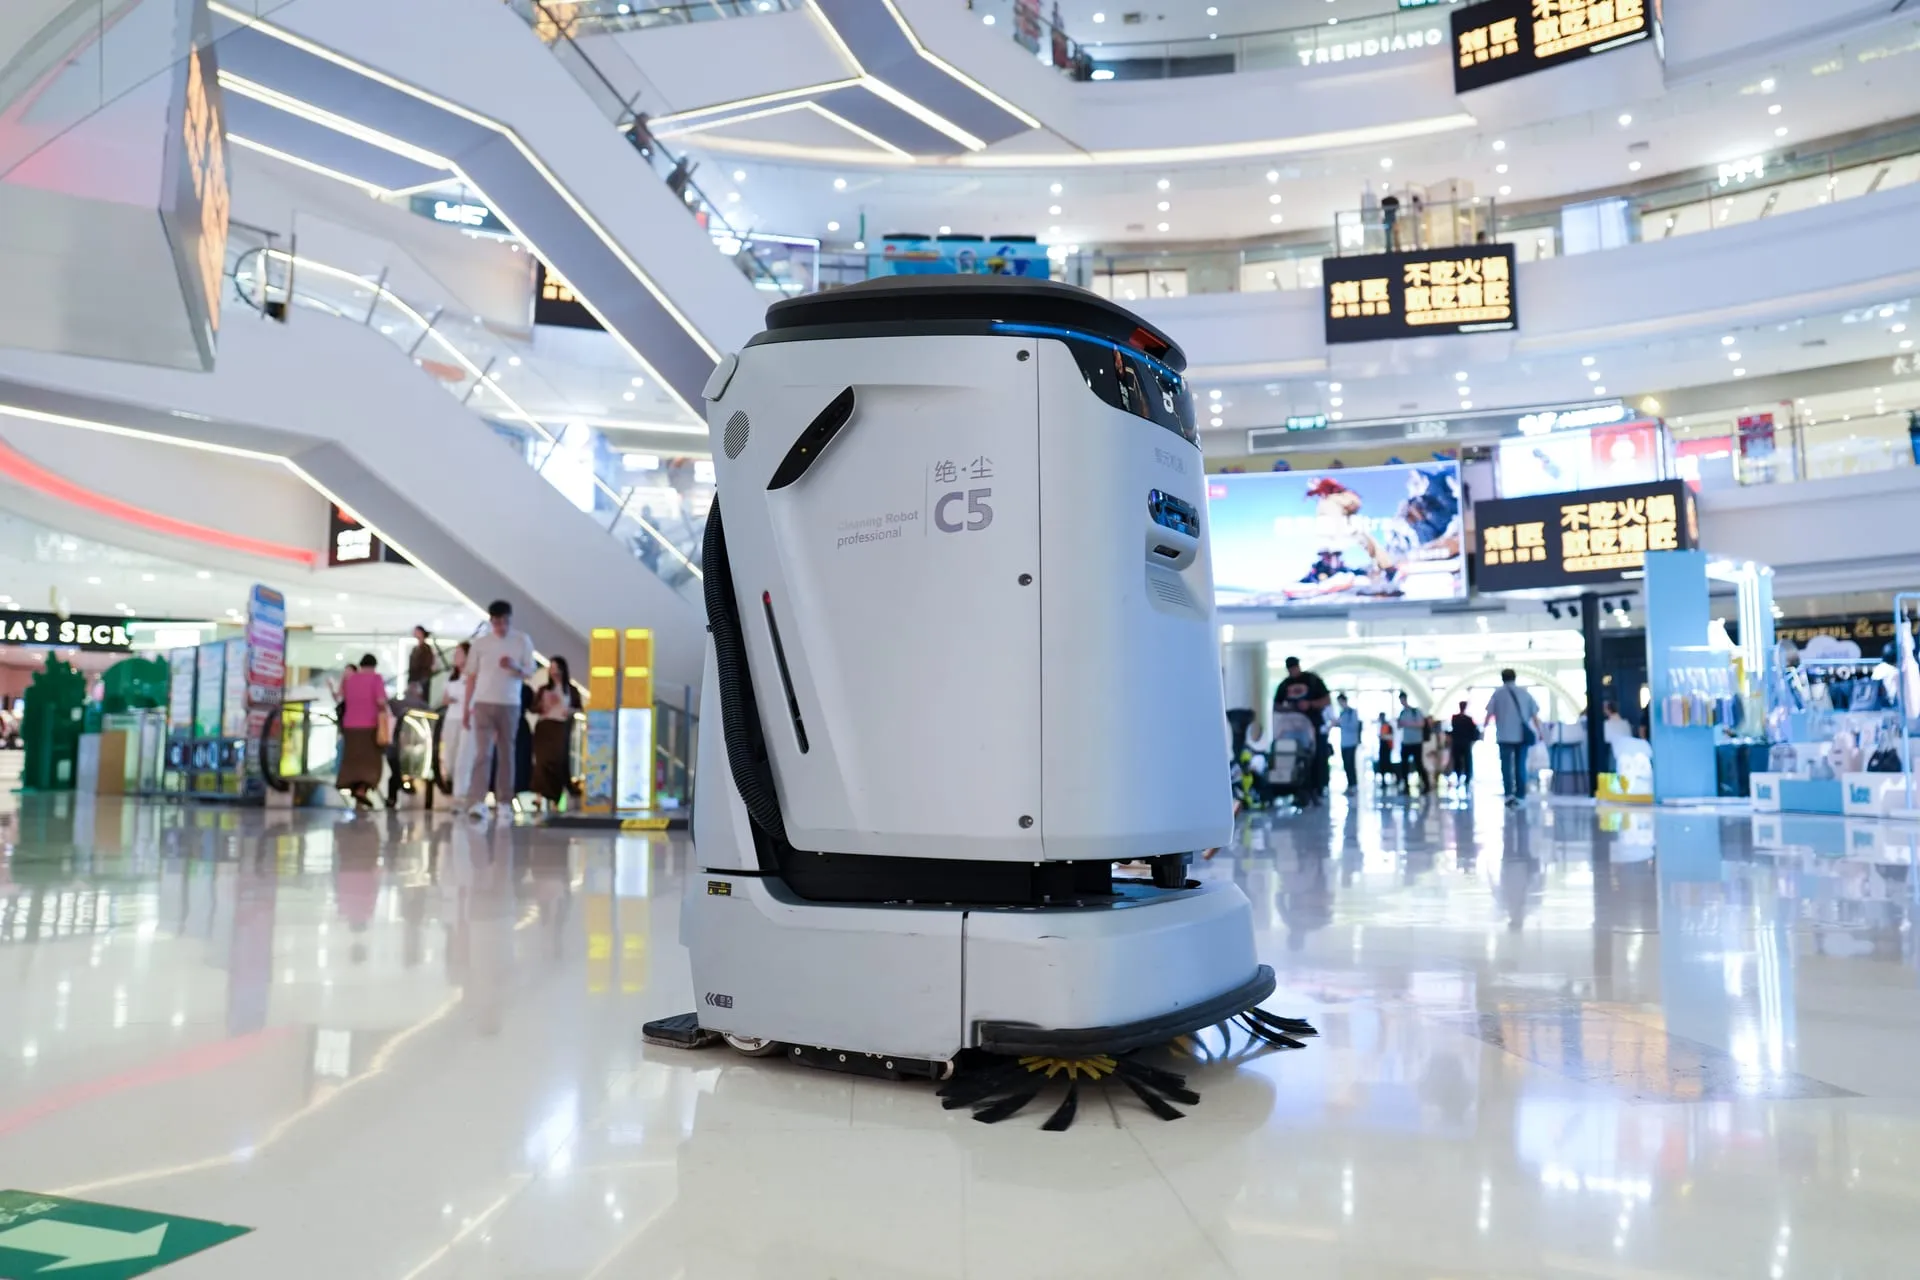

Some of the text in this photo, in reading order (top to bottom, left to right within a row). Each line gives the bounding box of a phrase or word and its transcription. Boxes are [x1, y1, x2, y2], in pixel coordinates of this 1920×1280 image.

[1297, 28, 1442, 66] TRENDIANO
[837, 510, 919, 531] Cleaning Robot
[934, 488, 993, 533] C5
[837, 526, 902, 550] professional
